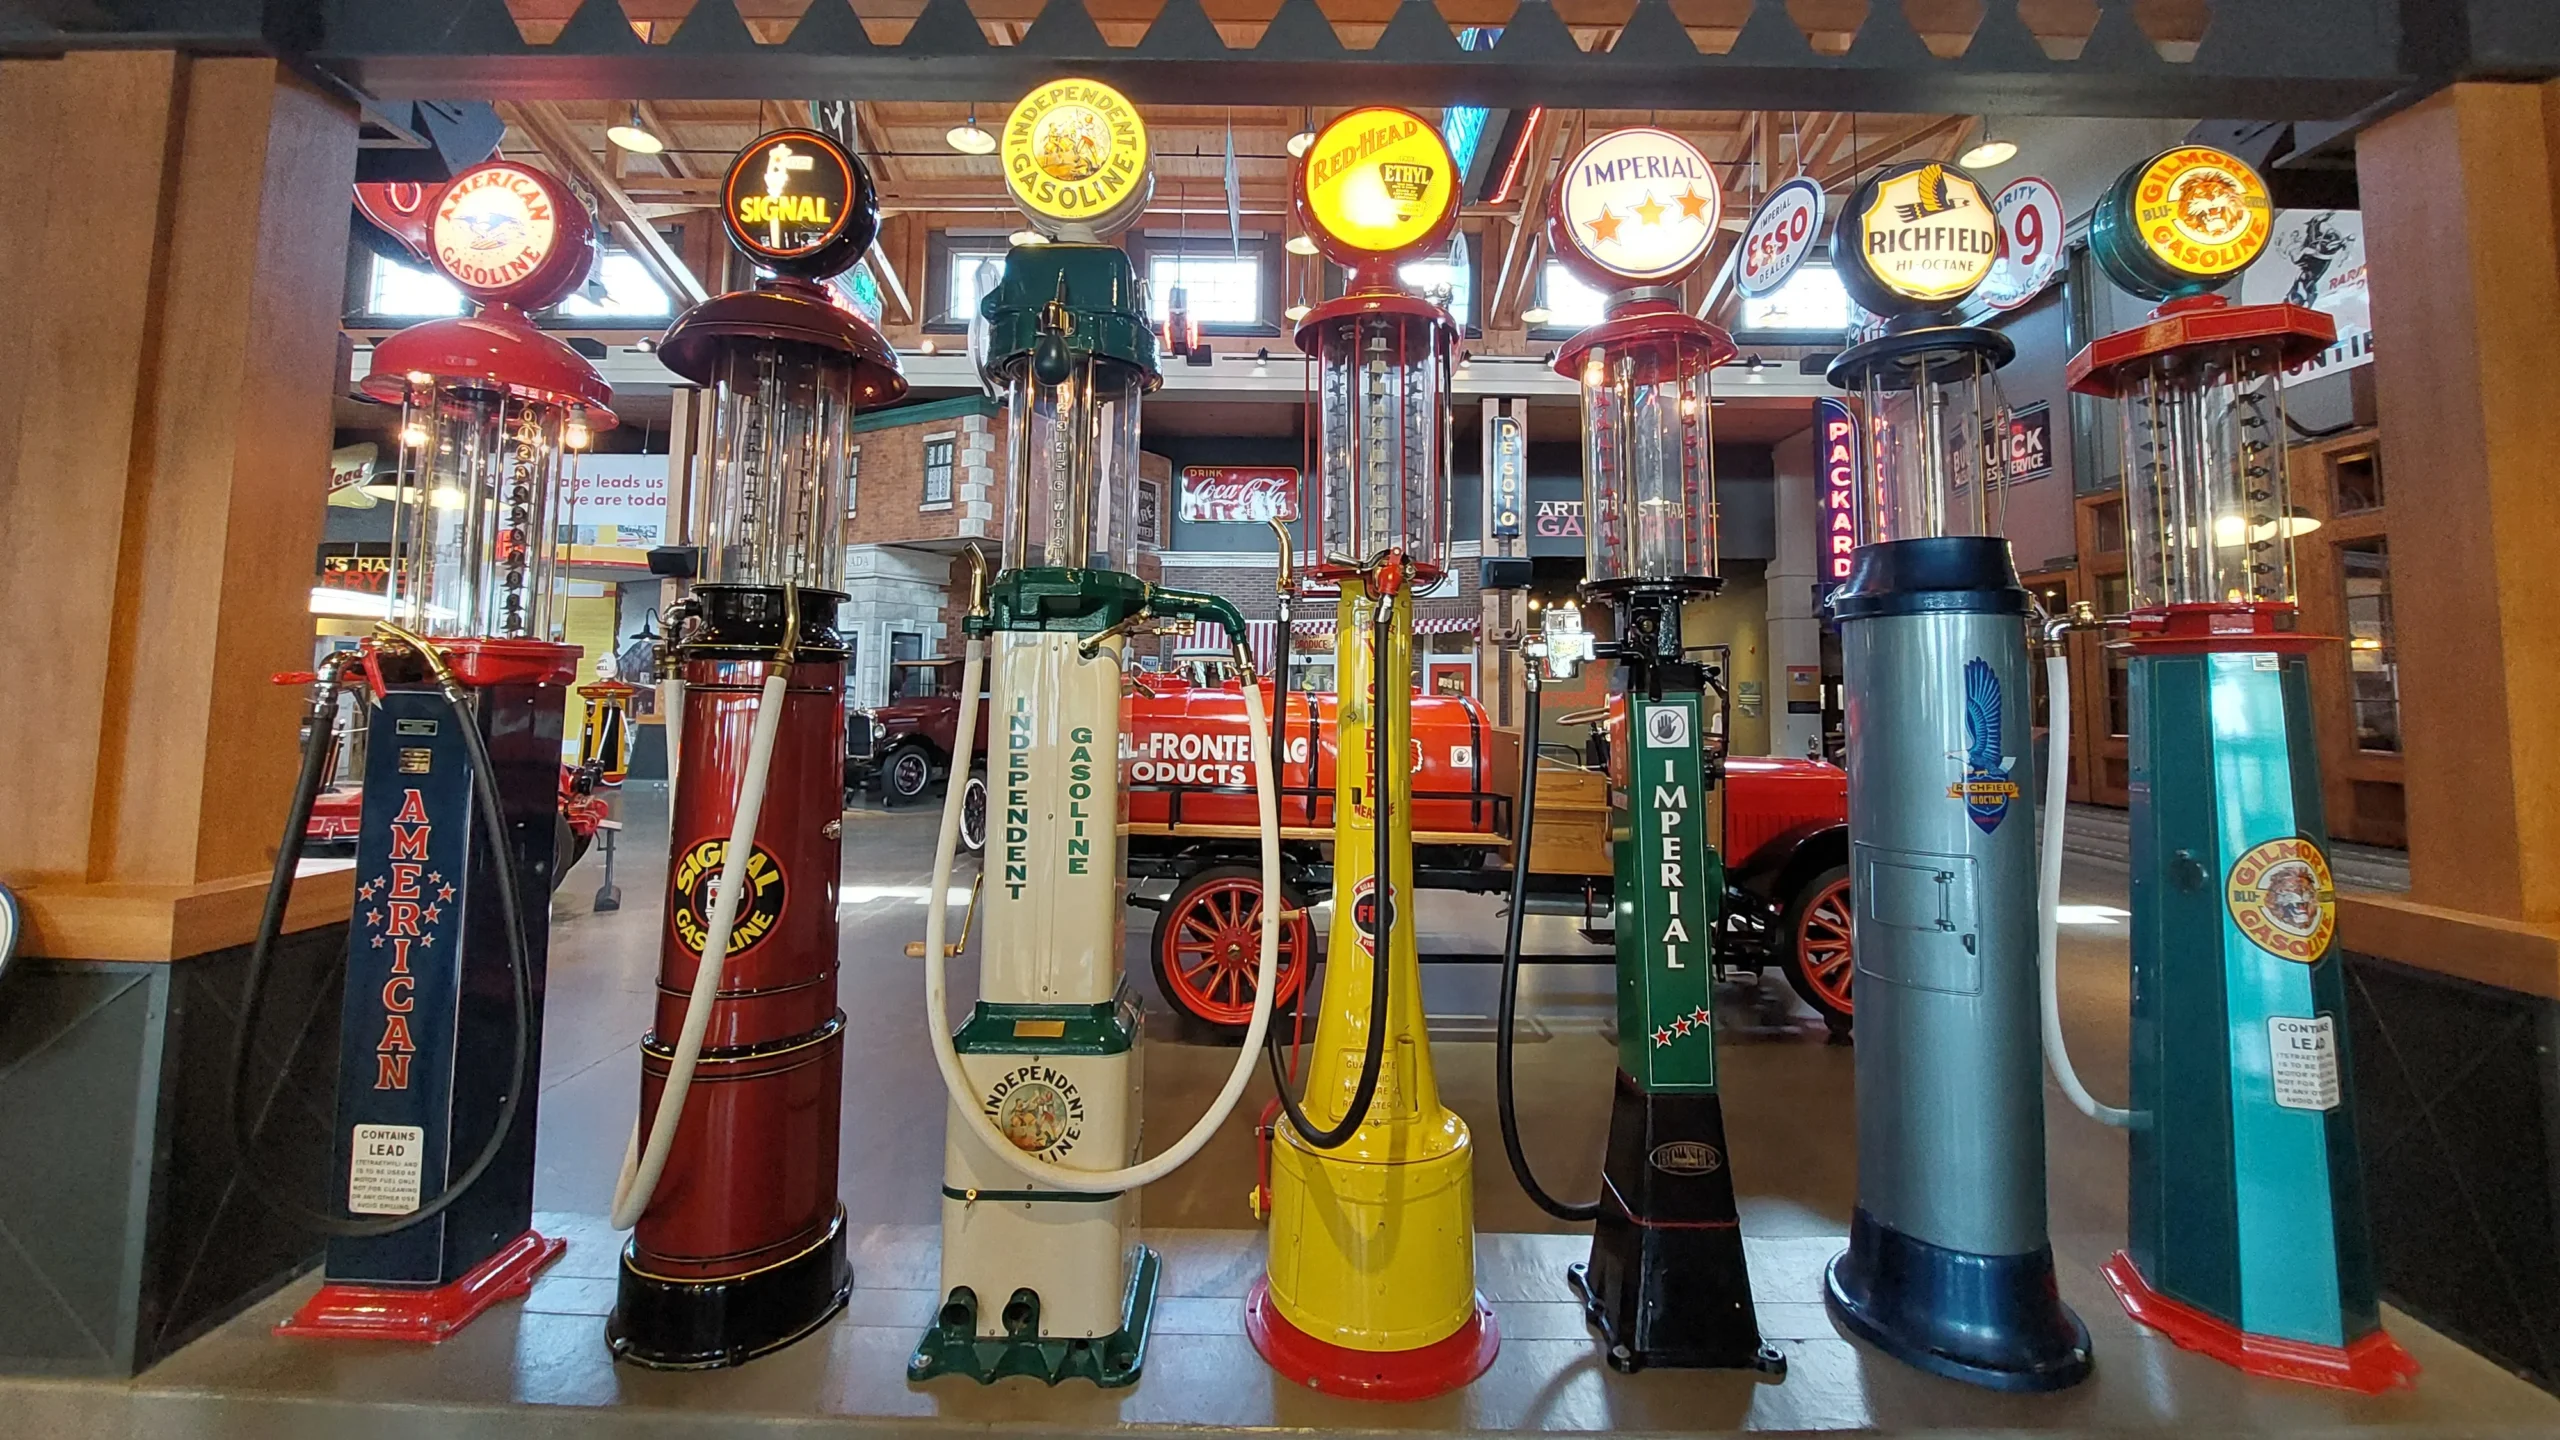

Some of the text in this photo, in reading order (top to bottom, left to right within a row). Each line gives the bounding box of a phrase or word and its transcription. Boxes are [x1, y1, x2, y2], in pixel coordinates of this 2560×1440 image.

[1010, 86, 1137, 151] INDEPENDENT
[1312, 120, 1418, 191] RED-HEAD
[1384, 164, 1430, 185] ETHYL
[1584, 155, 1702, 187] IMPERIAL
[2142, 151, 2258, 203] GILMORE
[440, 171, 550, 222] AMERICAN
[1012, 153, 1135, 210] GASOLINE
[1995, 186, 2038, 214] URITY
[739, 196, 831, 224] SIGNAL
[1760, 197, 1791, 230] IMPERIAL
[1868, 226, 1994, 256] RICHFIELD
[2153, 217, 2265, 268] GASOLINE
[442, 245, 541, 286] GASOLINE
[1759, 253, 1791, 285] DEALER
[596, 474, 640, 488] leads
[646, 478, 664, 488] us
[1190, 468, 1223, 478] DRINK
[1192, 476, 1290, 507] Coca-Cola
[564, 492, 666, 506] we are toda
[1828, 421, 1852, 578] PACKARD
[1131, 761, 1247, 785] ODUCTS
[1005, 697, 1031, 900] INDEPENDENT
[1067, 727, 1093, 875] GASOLINE
[677, 841, 779, 897] SIGAL
[1653, 759, 1689, 969] IMPERIAL
[2235, 841, 2329, 887] GILMORE
[373, 788, 430, 1091] AMERICAN
[676, 908, 774, 953] GASLINE
[2239, 908, 2333, 957] GASOLINE
[983, 1065, 1084, 1123] INDEPENDENT
[361, 1129, 416, 1141] CONTAINS
[369, 1143, 405, 1157] LEAD
